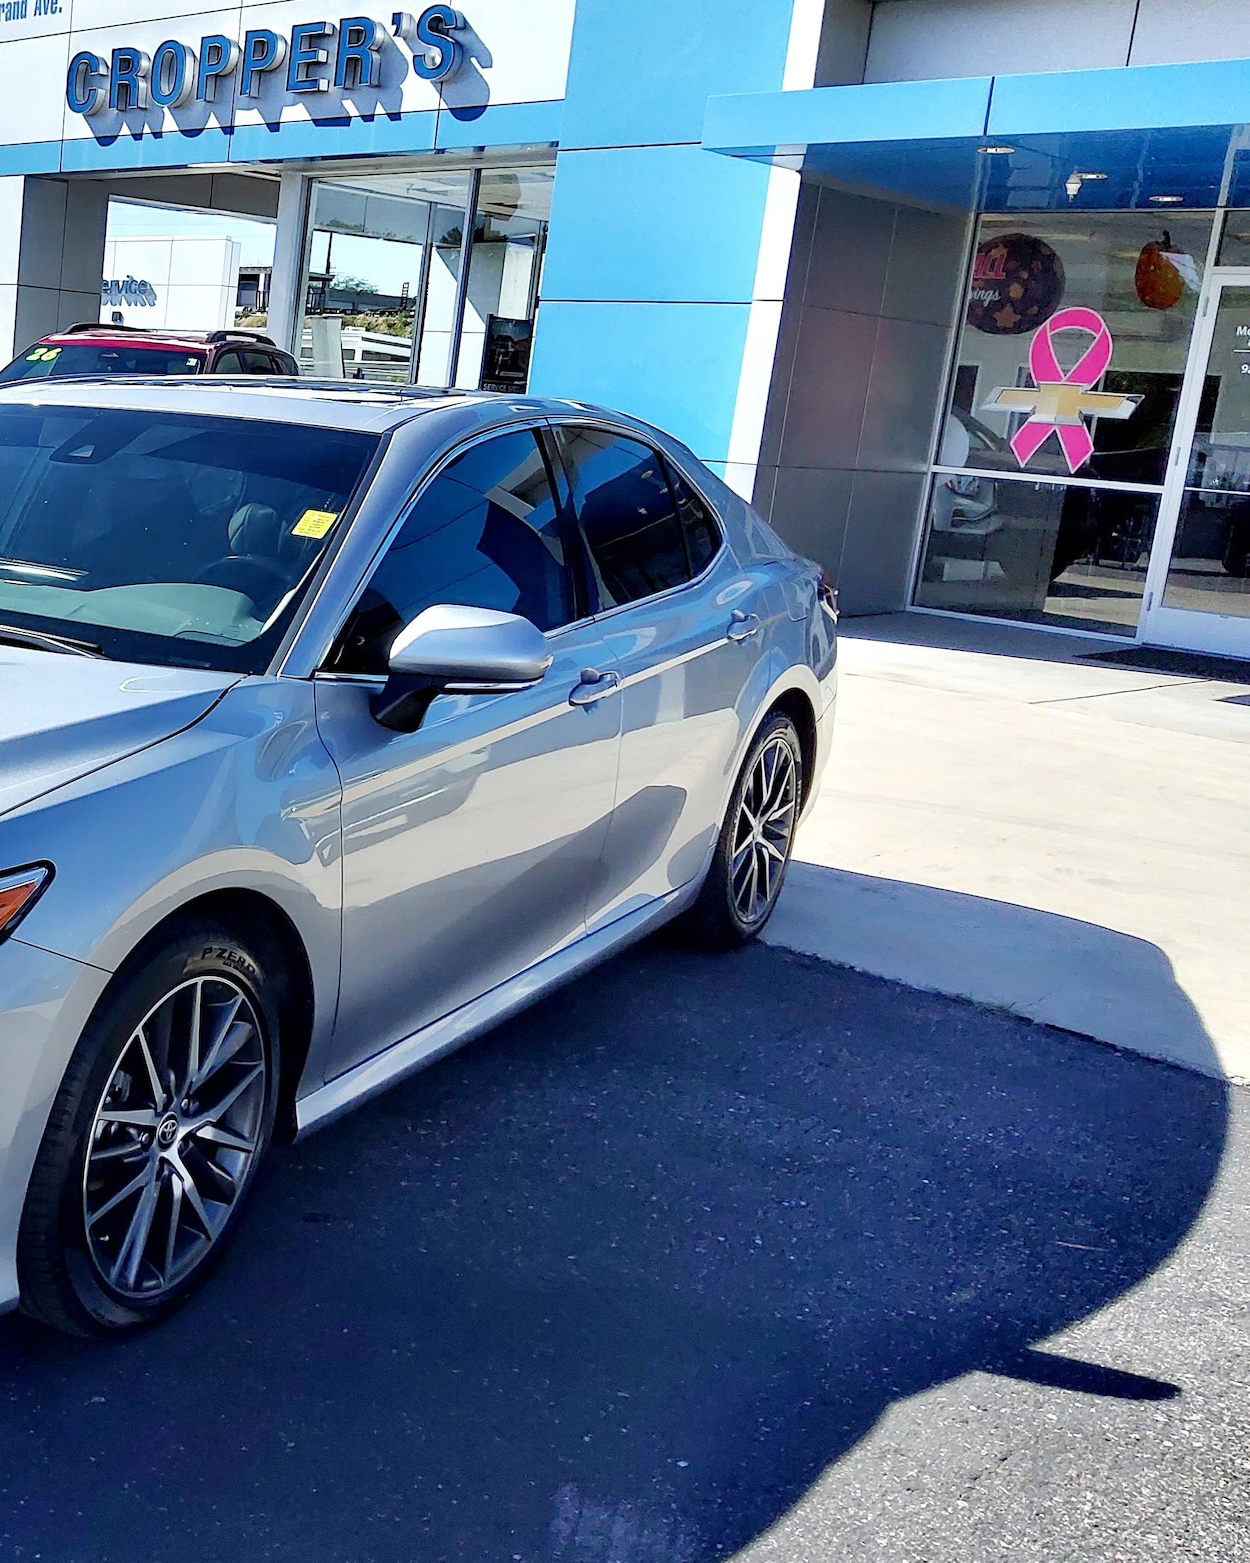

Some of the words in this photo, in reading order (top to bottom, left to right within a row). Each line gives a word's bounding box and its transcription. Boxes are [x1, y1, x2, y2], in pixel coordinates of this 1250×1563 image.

[34, 0, 63, 17] Ave.
[66, 4, 463, 115] CROPPER'S
[25, 347, 63, 361] 26
